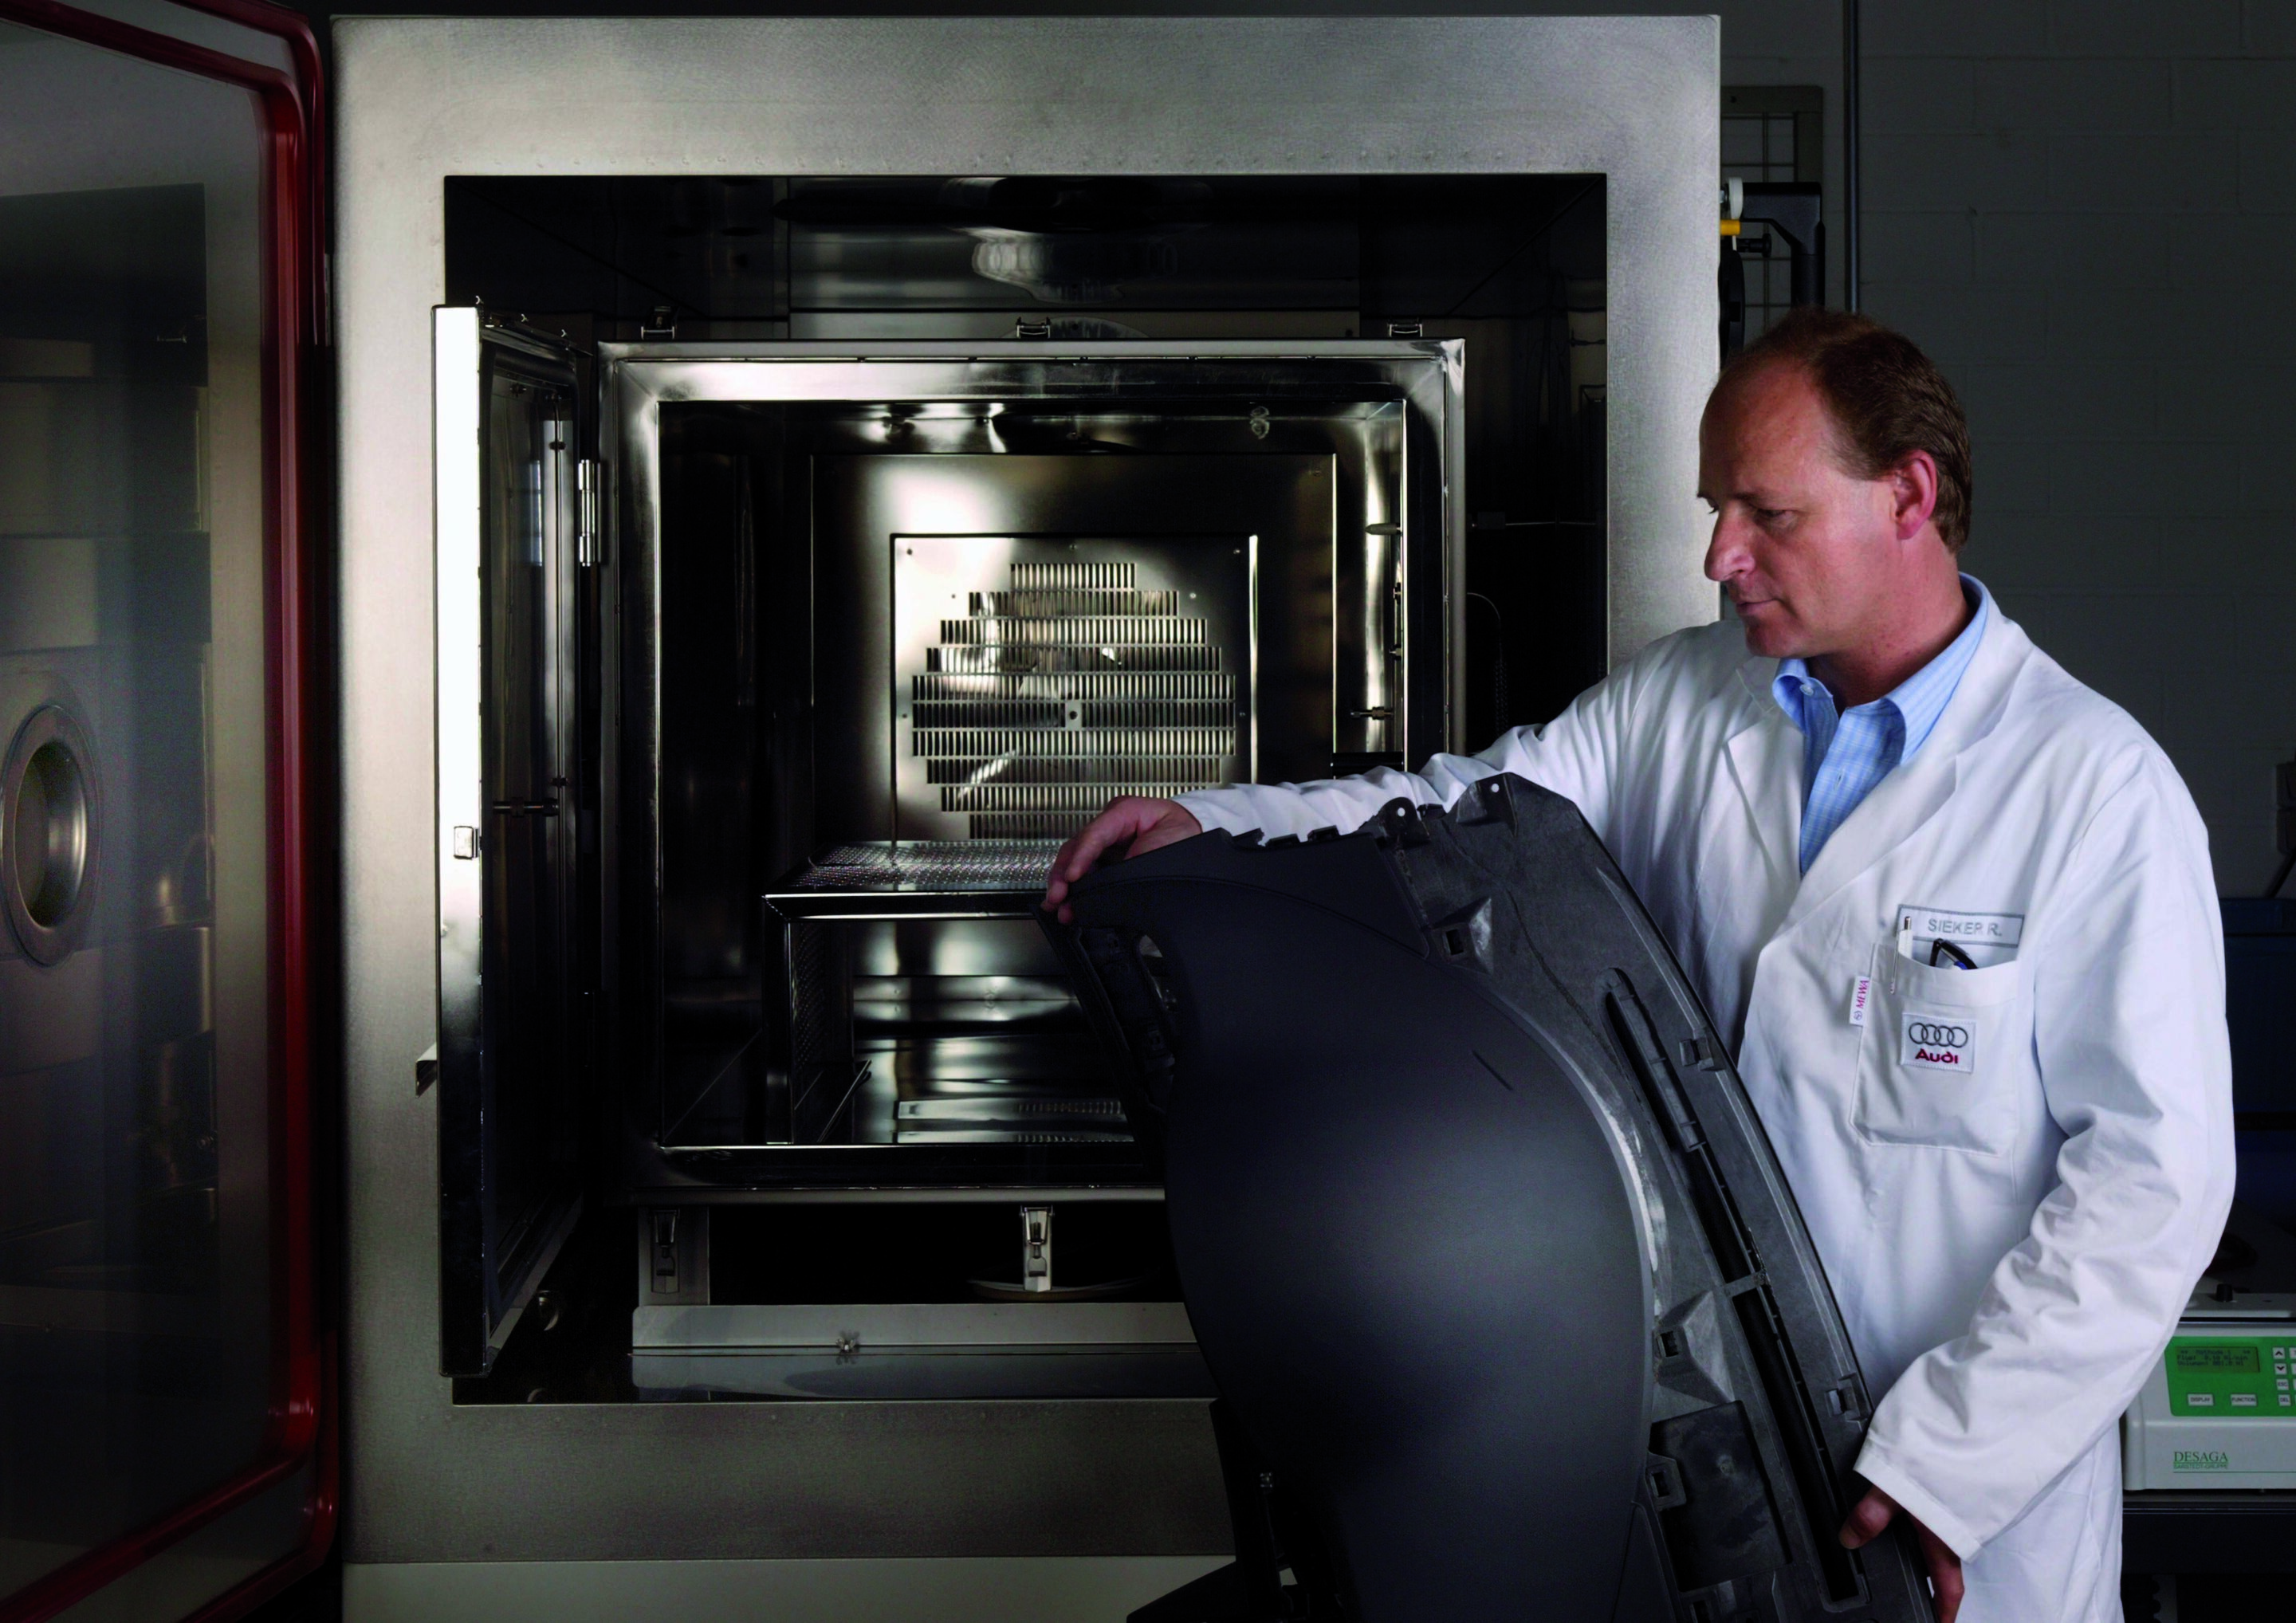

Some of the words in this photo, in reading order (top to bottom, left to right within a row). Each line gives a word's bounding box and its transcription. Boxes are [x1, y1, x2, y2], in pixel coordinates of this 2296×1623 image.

[1928, 918, 1983, 935] SIEKER
[1987, 922, 2003, 937] R.
[1915, 1048, 1959, 1064] Audi
[2174, 1451, 2228, 1462] DESAGA
